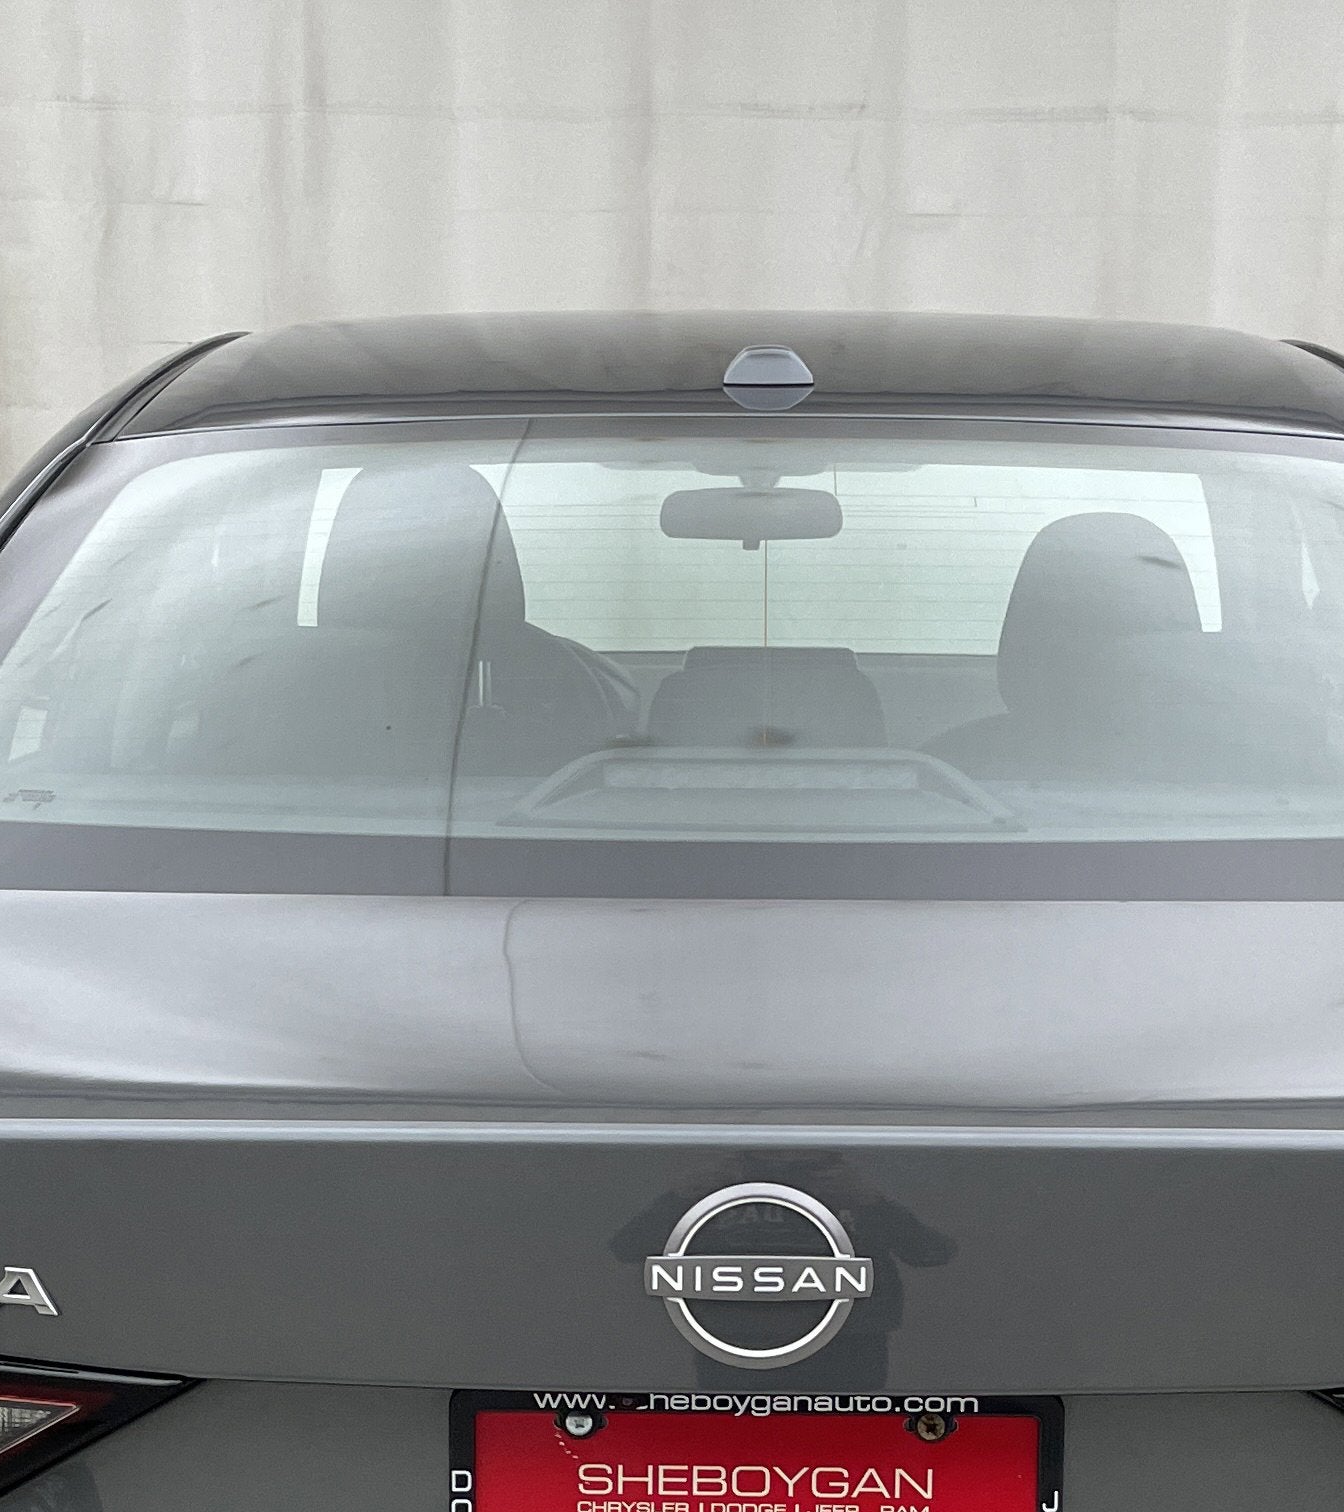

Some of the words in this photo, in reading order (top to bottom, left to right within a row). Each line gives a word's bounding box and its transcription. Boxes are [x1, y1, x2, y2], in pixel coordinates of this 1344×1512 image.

[652, 1265, 866, 1292] NISSAN
[533, 1392, 979, 1417] wwwheboyganauto.com
[577, 1463, 933, 1500] SHEBOYGAN
